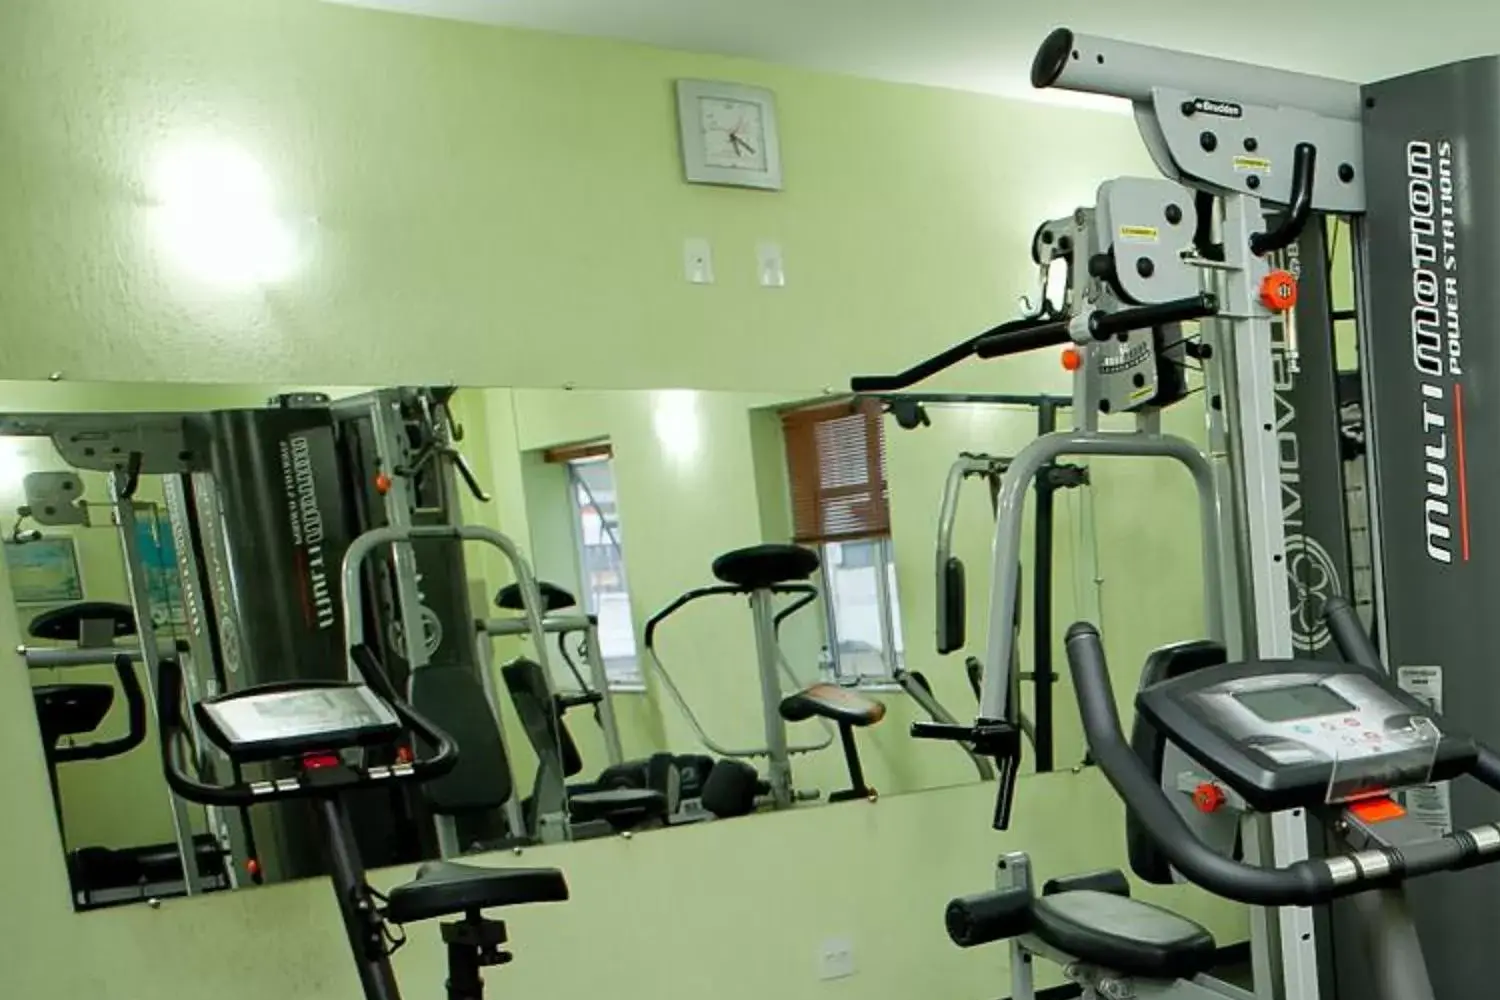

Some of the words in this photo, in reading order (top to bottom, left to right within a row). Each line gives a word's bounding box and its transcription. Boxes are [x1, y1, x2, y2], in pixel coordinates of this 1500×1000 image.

[1407, 140, 1443, 376] MOTION
[1437, 141, 1457, 271] STATIONS
[1445, 278, 1463, 376] POWER
[1422, 383, 1453, 565] MULTI
